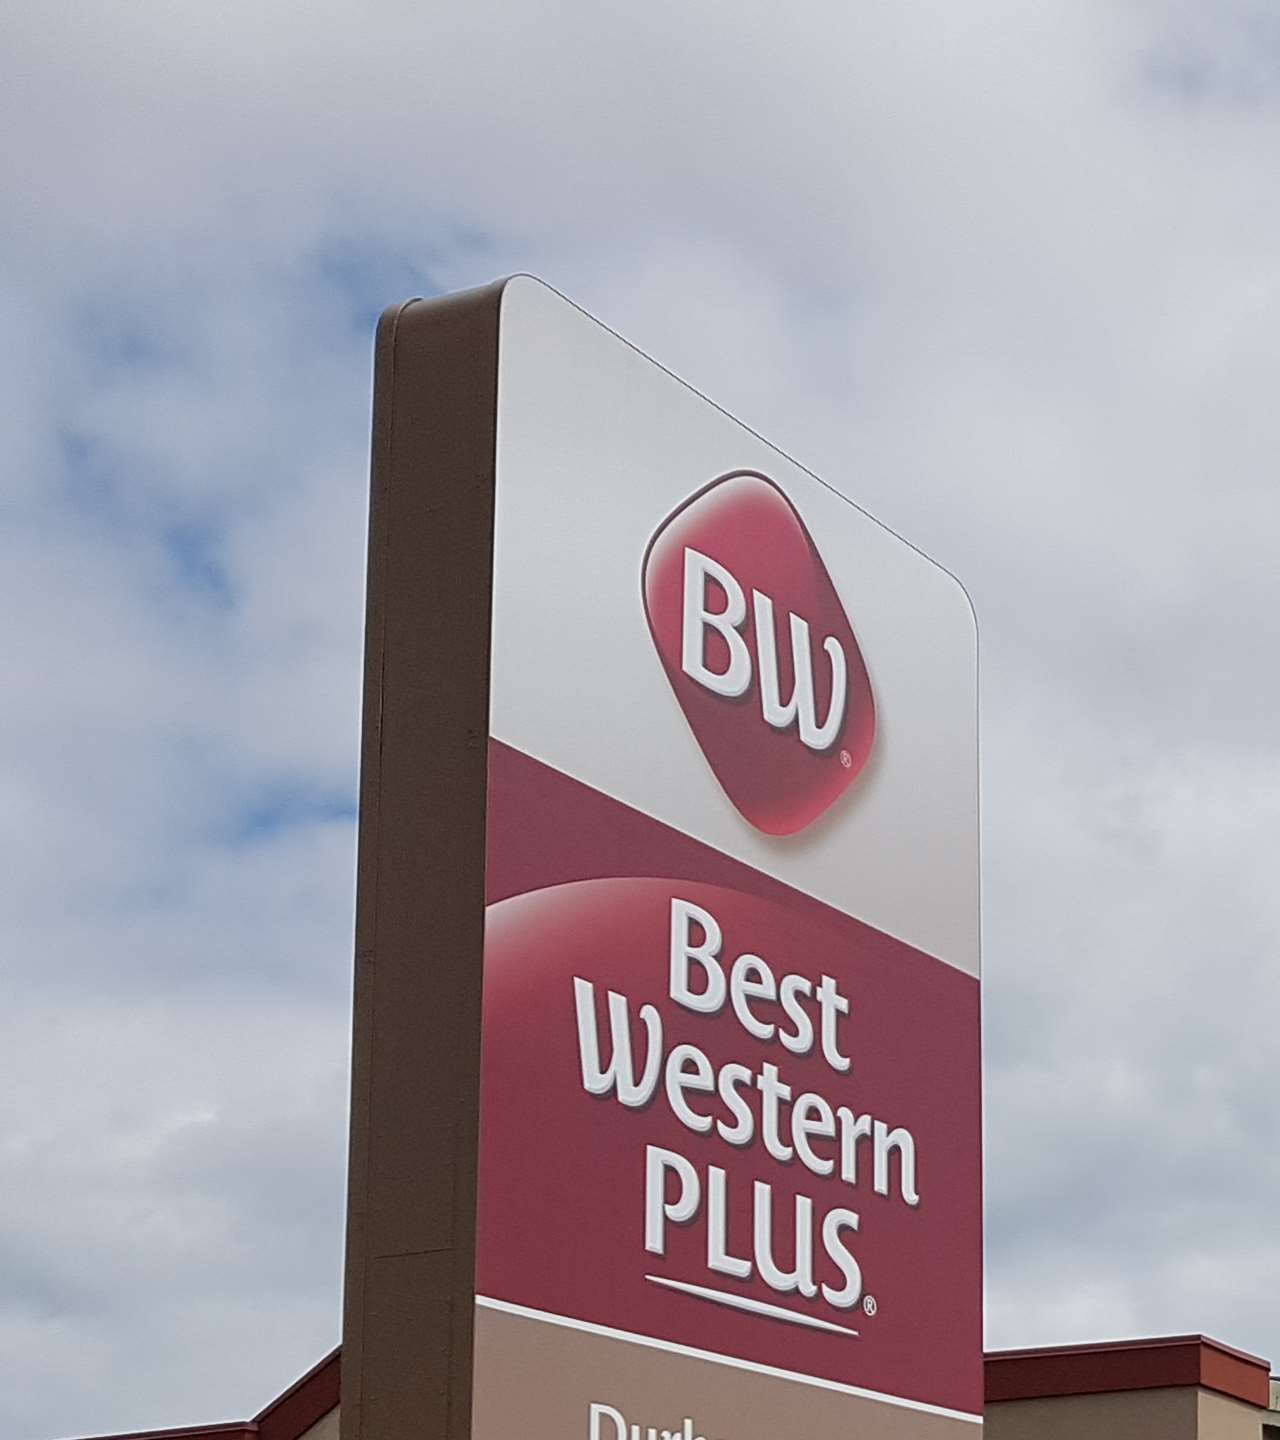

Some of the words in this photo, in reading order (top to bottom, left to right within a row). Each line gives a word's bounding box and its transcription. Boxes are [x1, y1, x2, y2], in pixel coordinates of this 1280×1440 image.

[681, 546, 847, 751] BW
[669, 897, 850, 1071] Best
[573, 975, 919, 1206] Western
[644, 1144, 863, 1308] PLUS
